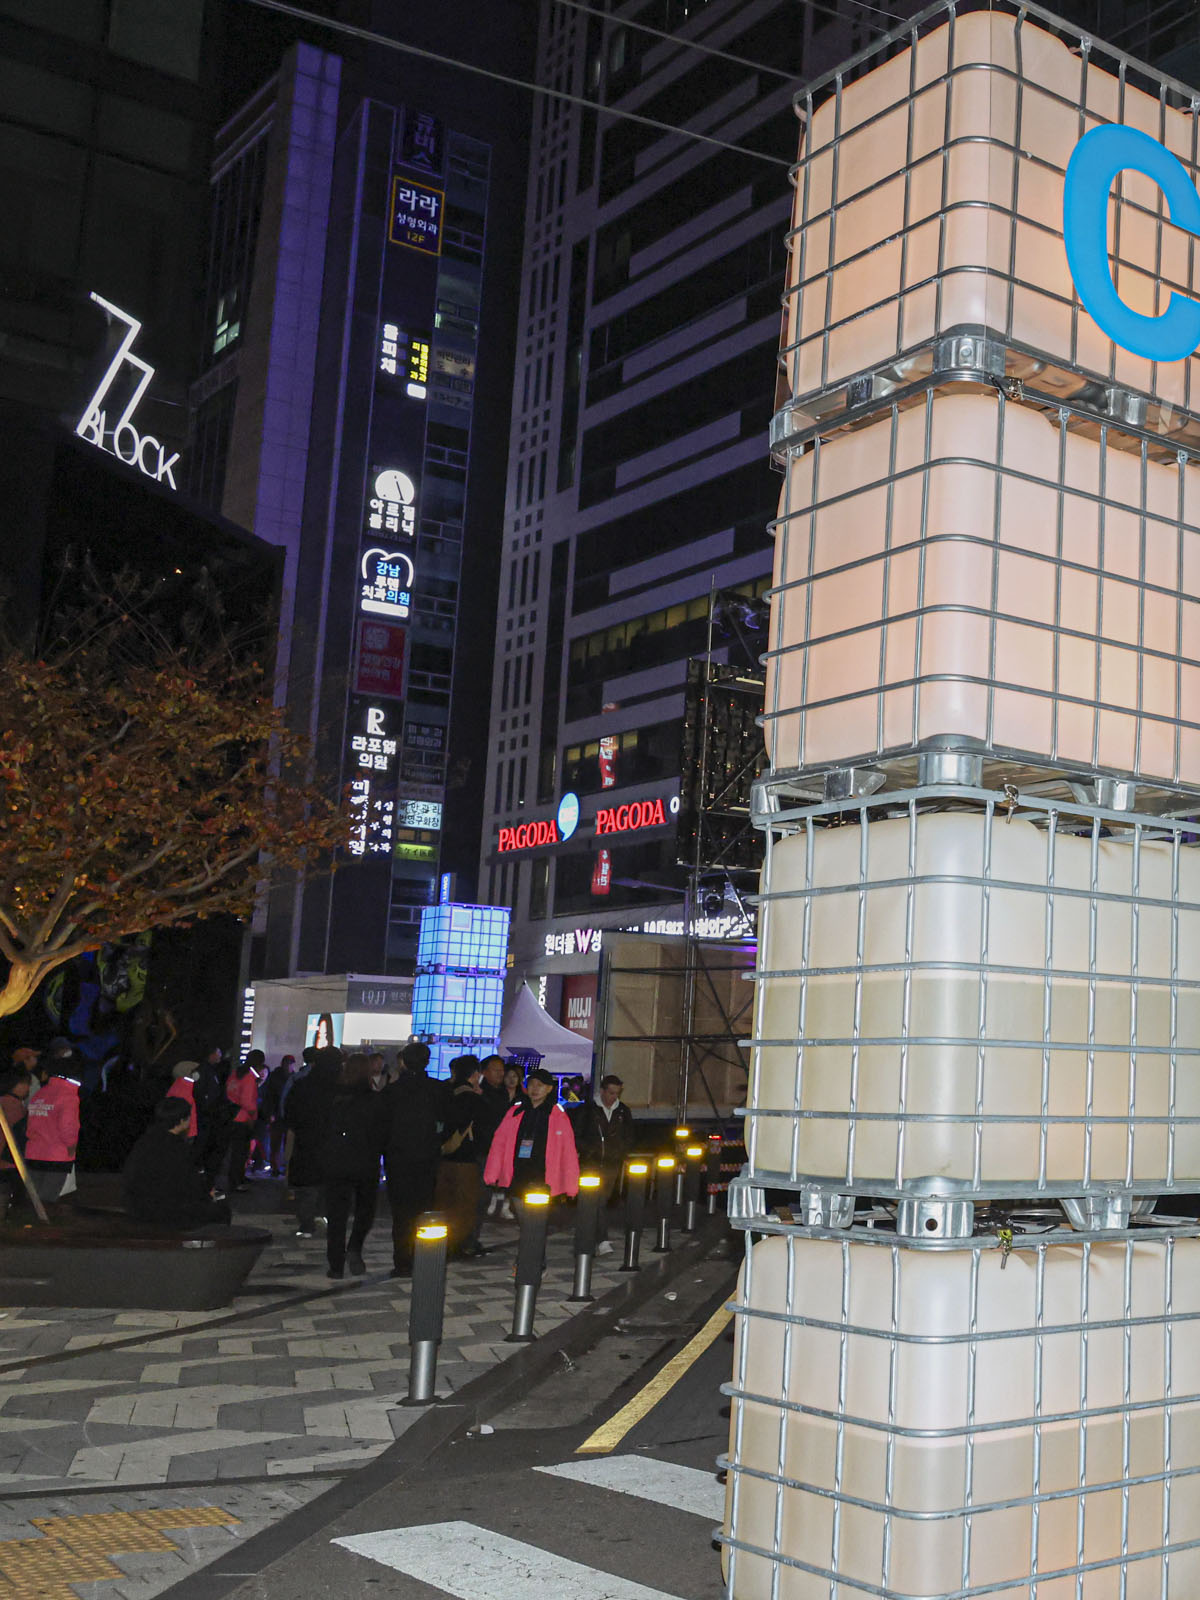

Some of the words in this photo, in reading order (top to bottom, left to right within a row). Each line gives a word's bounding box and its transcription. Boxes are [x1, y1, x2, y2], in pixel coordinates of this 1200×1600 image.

[400, 188, 439, 218] 라라
[78, 406, 181, 491] BLOCK
[376, 562, 401, 577] 강남
[596, 799, 666, 835] PAGODA
[498, 819, 558, 852] PAGODA
[567, 997, 592, 1018] MUJI
